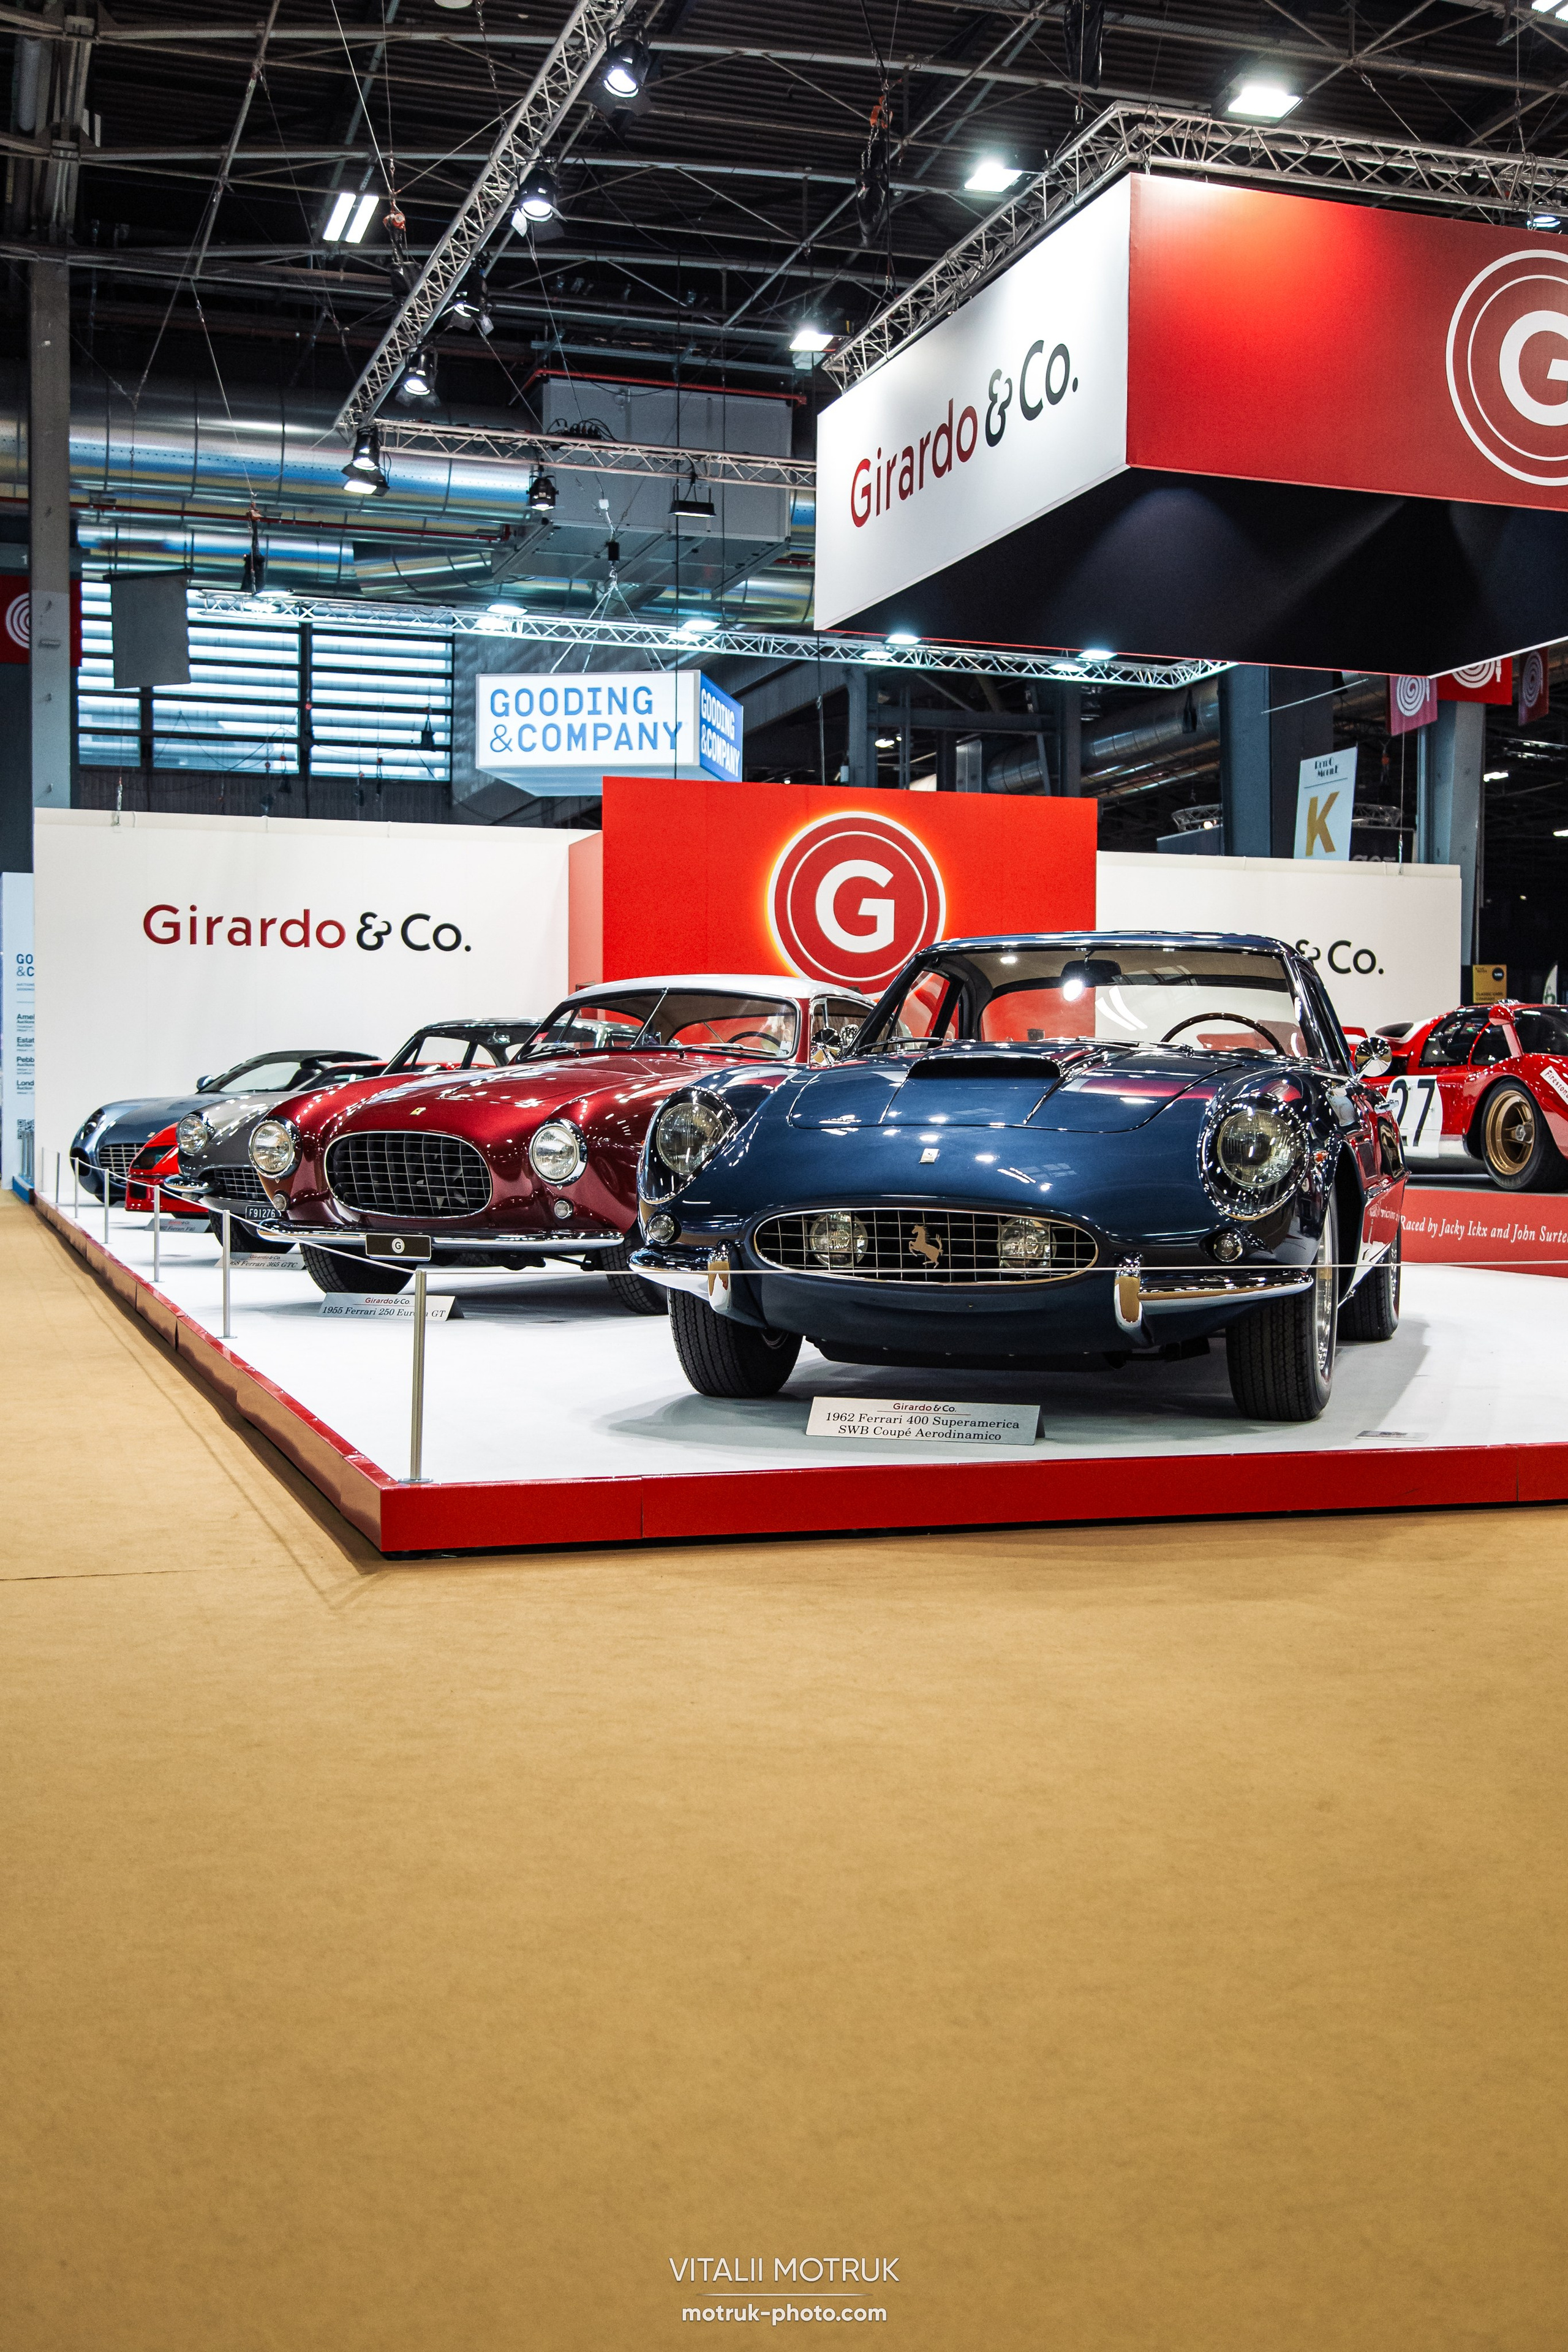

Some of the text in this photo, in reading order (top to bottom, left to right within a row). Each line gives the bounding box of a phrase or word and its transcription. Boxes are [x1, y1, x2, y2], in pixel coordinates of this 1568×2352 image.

[1499, 311, 1568, 426] G
[851, 398, 978, 527] Girardo
[1020, 340, 1078, 421] Co.
[491, 686, 653, 717] GOODING
[701, 688, 735, 741] GOODING
[490, 722, 682, 752] &COMPANY
[701, 724, 740, 777] &COMPANY
[1306, 791, 1340, 856] K
[815, 859, 895, 953] G
[143, 904, 346, 948] Girardo
[401, 913, 472, 952] Co.
[1328, 940, 1384, 974] Co.
[1392, 1079, 1436, 1147] 27
[249, 1208, 276, 1218] F91276
[1400, 1215, 1568, 1243] Raced by Jacky Ickx and John Surte
[322, 1306, 343, 1314] 1955
[826, 1412, 1020, 1429] 1962 Ferrari 400 Superamerica
[893, 1403, 932, 1411] Girardo
[838, 1425, 1001, 1441] SWB Coupé Aerodinamico
